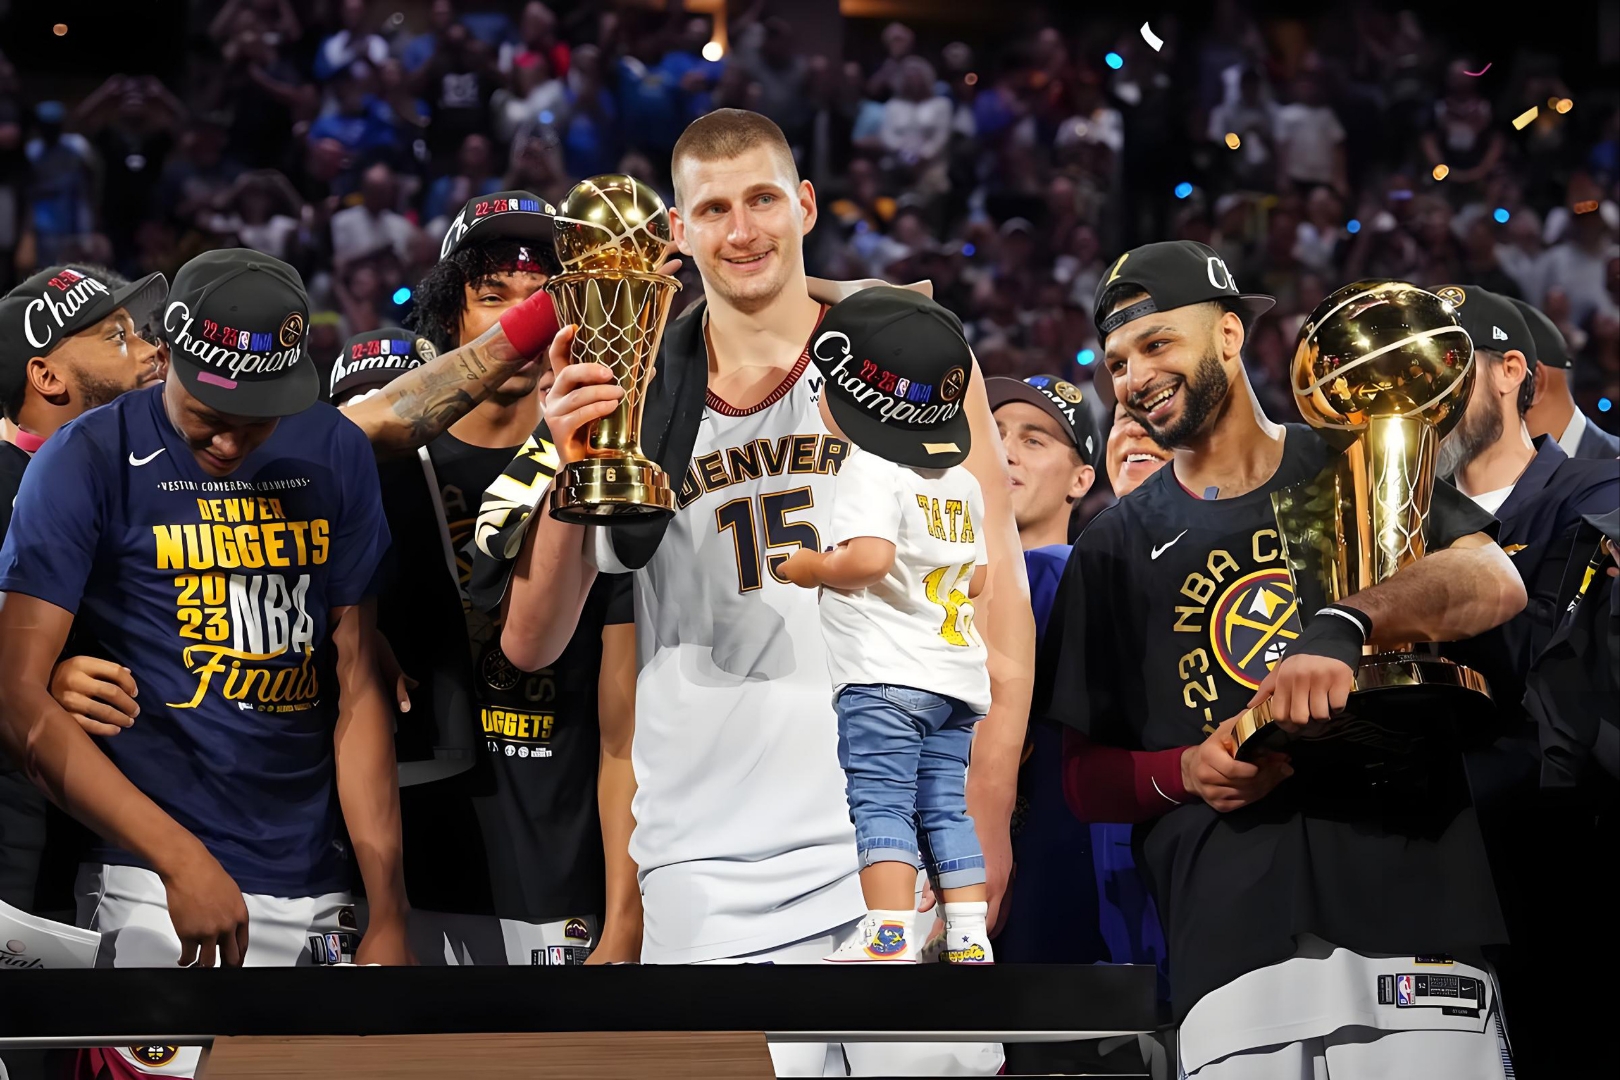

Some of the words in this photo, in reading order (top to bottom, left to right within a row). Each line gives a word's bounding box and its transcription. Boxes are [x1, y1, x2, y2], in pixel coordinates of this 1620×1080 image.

[475, 200, 508, 216] 22-23
[164, 301, 301, 380] Champions
[203, 319, 238, 347] 22-23
[351, 339, 380, 360] 22-23
[813, 330, 961, 424] Champions
[860, 358, 899, 393] 22-23
[677, 433, 851, 511] DENVER
[197, 497, 287, 523] DENVER
[916, 493, 975, 543] TATA
[152, 518, 330, 570] NUGGETS
[715, 485, 822, 594] 15
[174, 571, 227, 606] 20
[1173, 549, 1241, 633] NBA
[176, 607, 230, 642] 23
[229, 573, 315, 655] NBA
[165, 644, 319, 709] Finals
[480, 708, 555, 739] UGGETS
